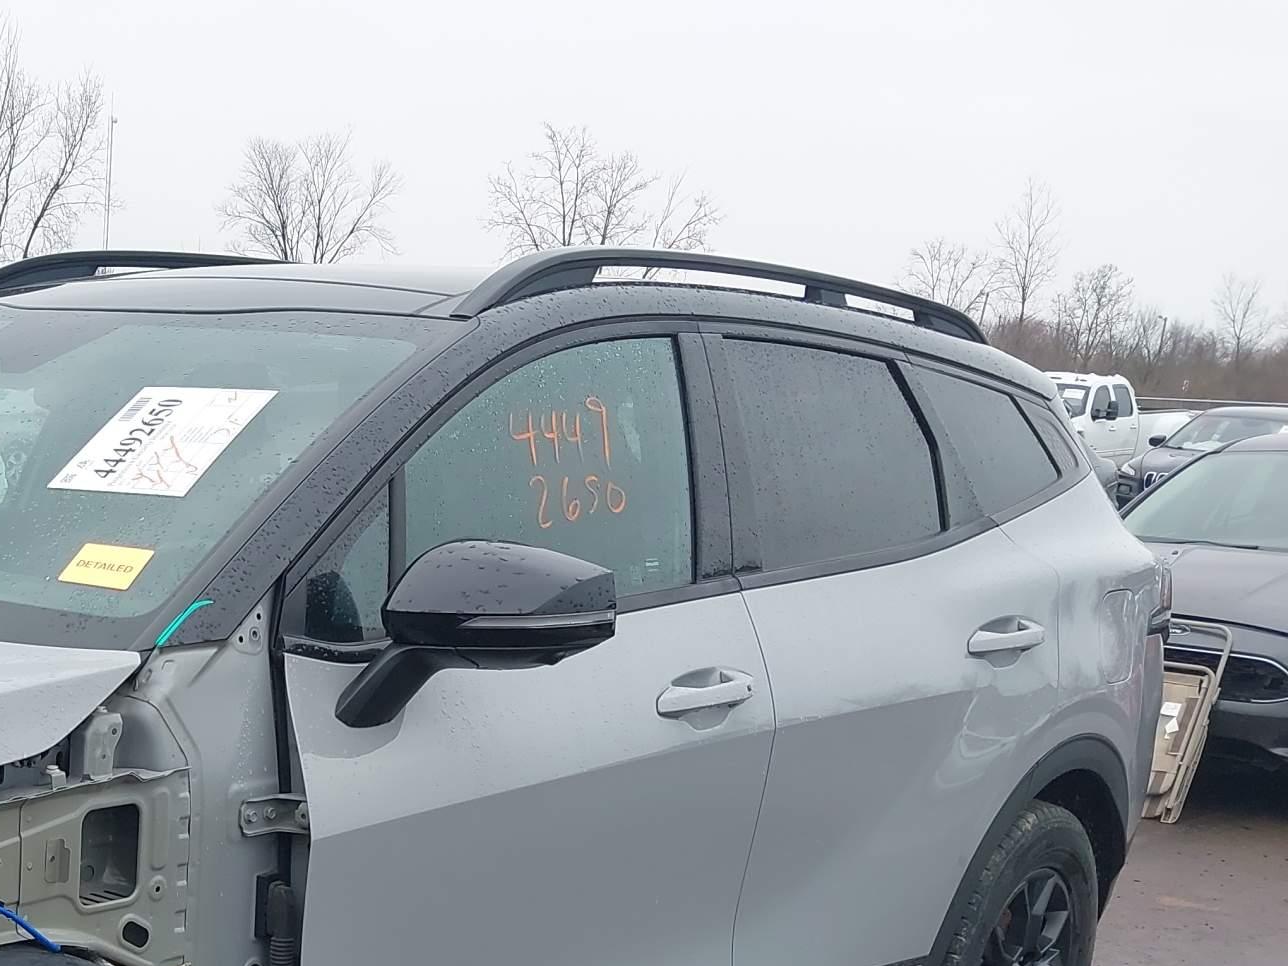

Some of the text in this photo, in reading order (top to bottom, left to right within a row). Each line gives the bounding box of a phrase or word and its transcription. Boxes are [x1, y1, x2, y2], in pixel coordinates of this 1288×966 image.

[93, 398, 184, 479] 44492650
[508, 394, 612, 471] 4449
[529, 474, 627, 530] 2650
[75, 558, 135, 576] DETAILED
